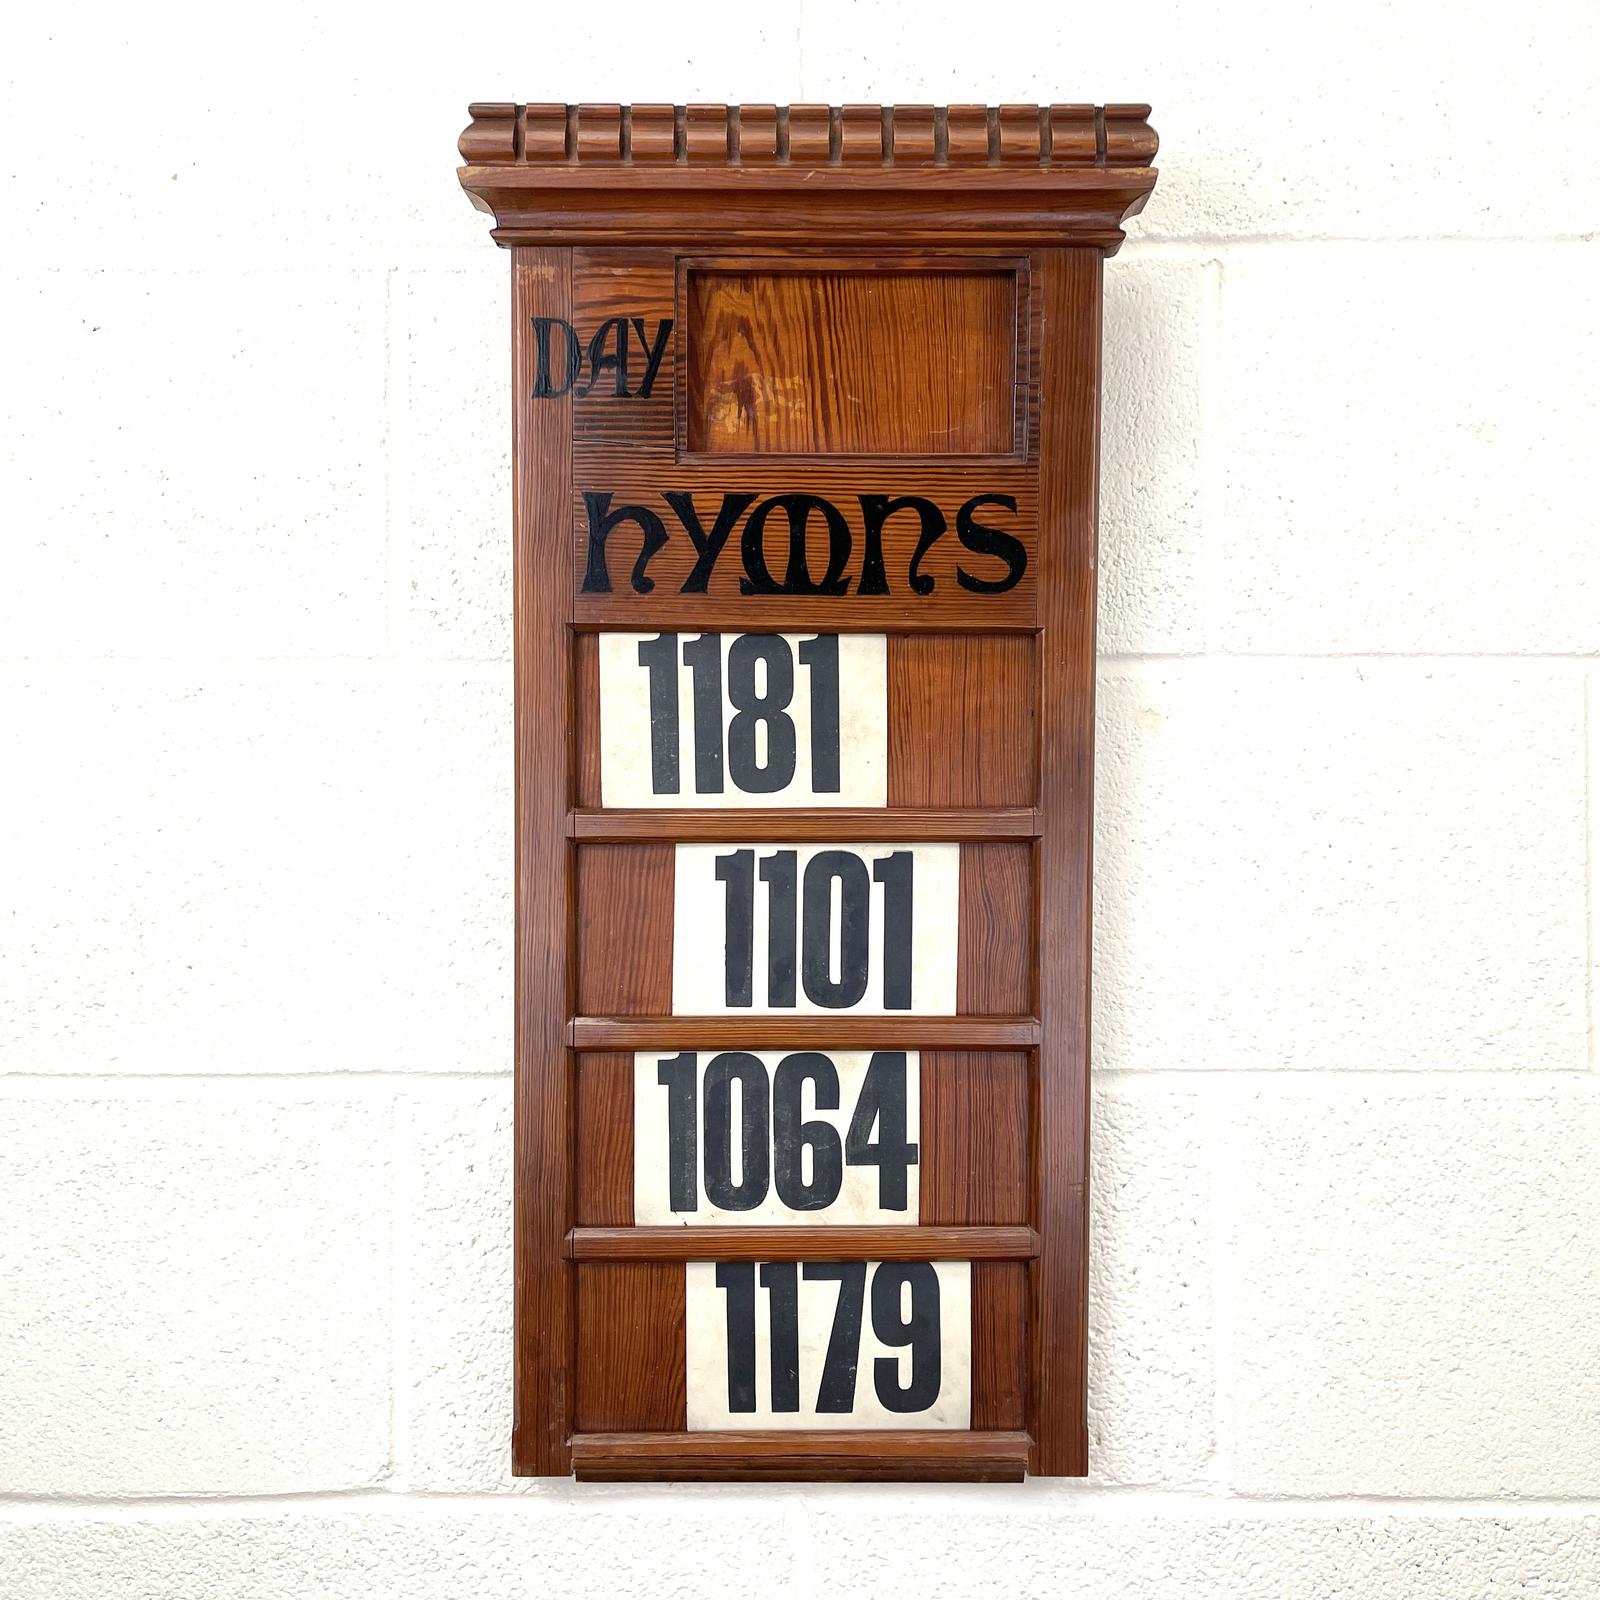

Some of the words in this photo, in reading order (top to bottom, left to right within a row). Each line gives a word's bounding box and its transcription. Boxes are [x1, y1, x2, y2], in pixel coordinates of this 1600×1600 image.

[531, 316, 674, 399] DAY
[638, 633, 840, 795] 1181
[715, 849, 913, 1010] 1101
[657, 1052, 918, 1213] 1064
[715, 1262, 941, 1414] 1179
